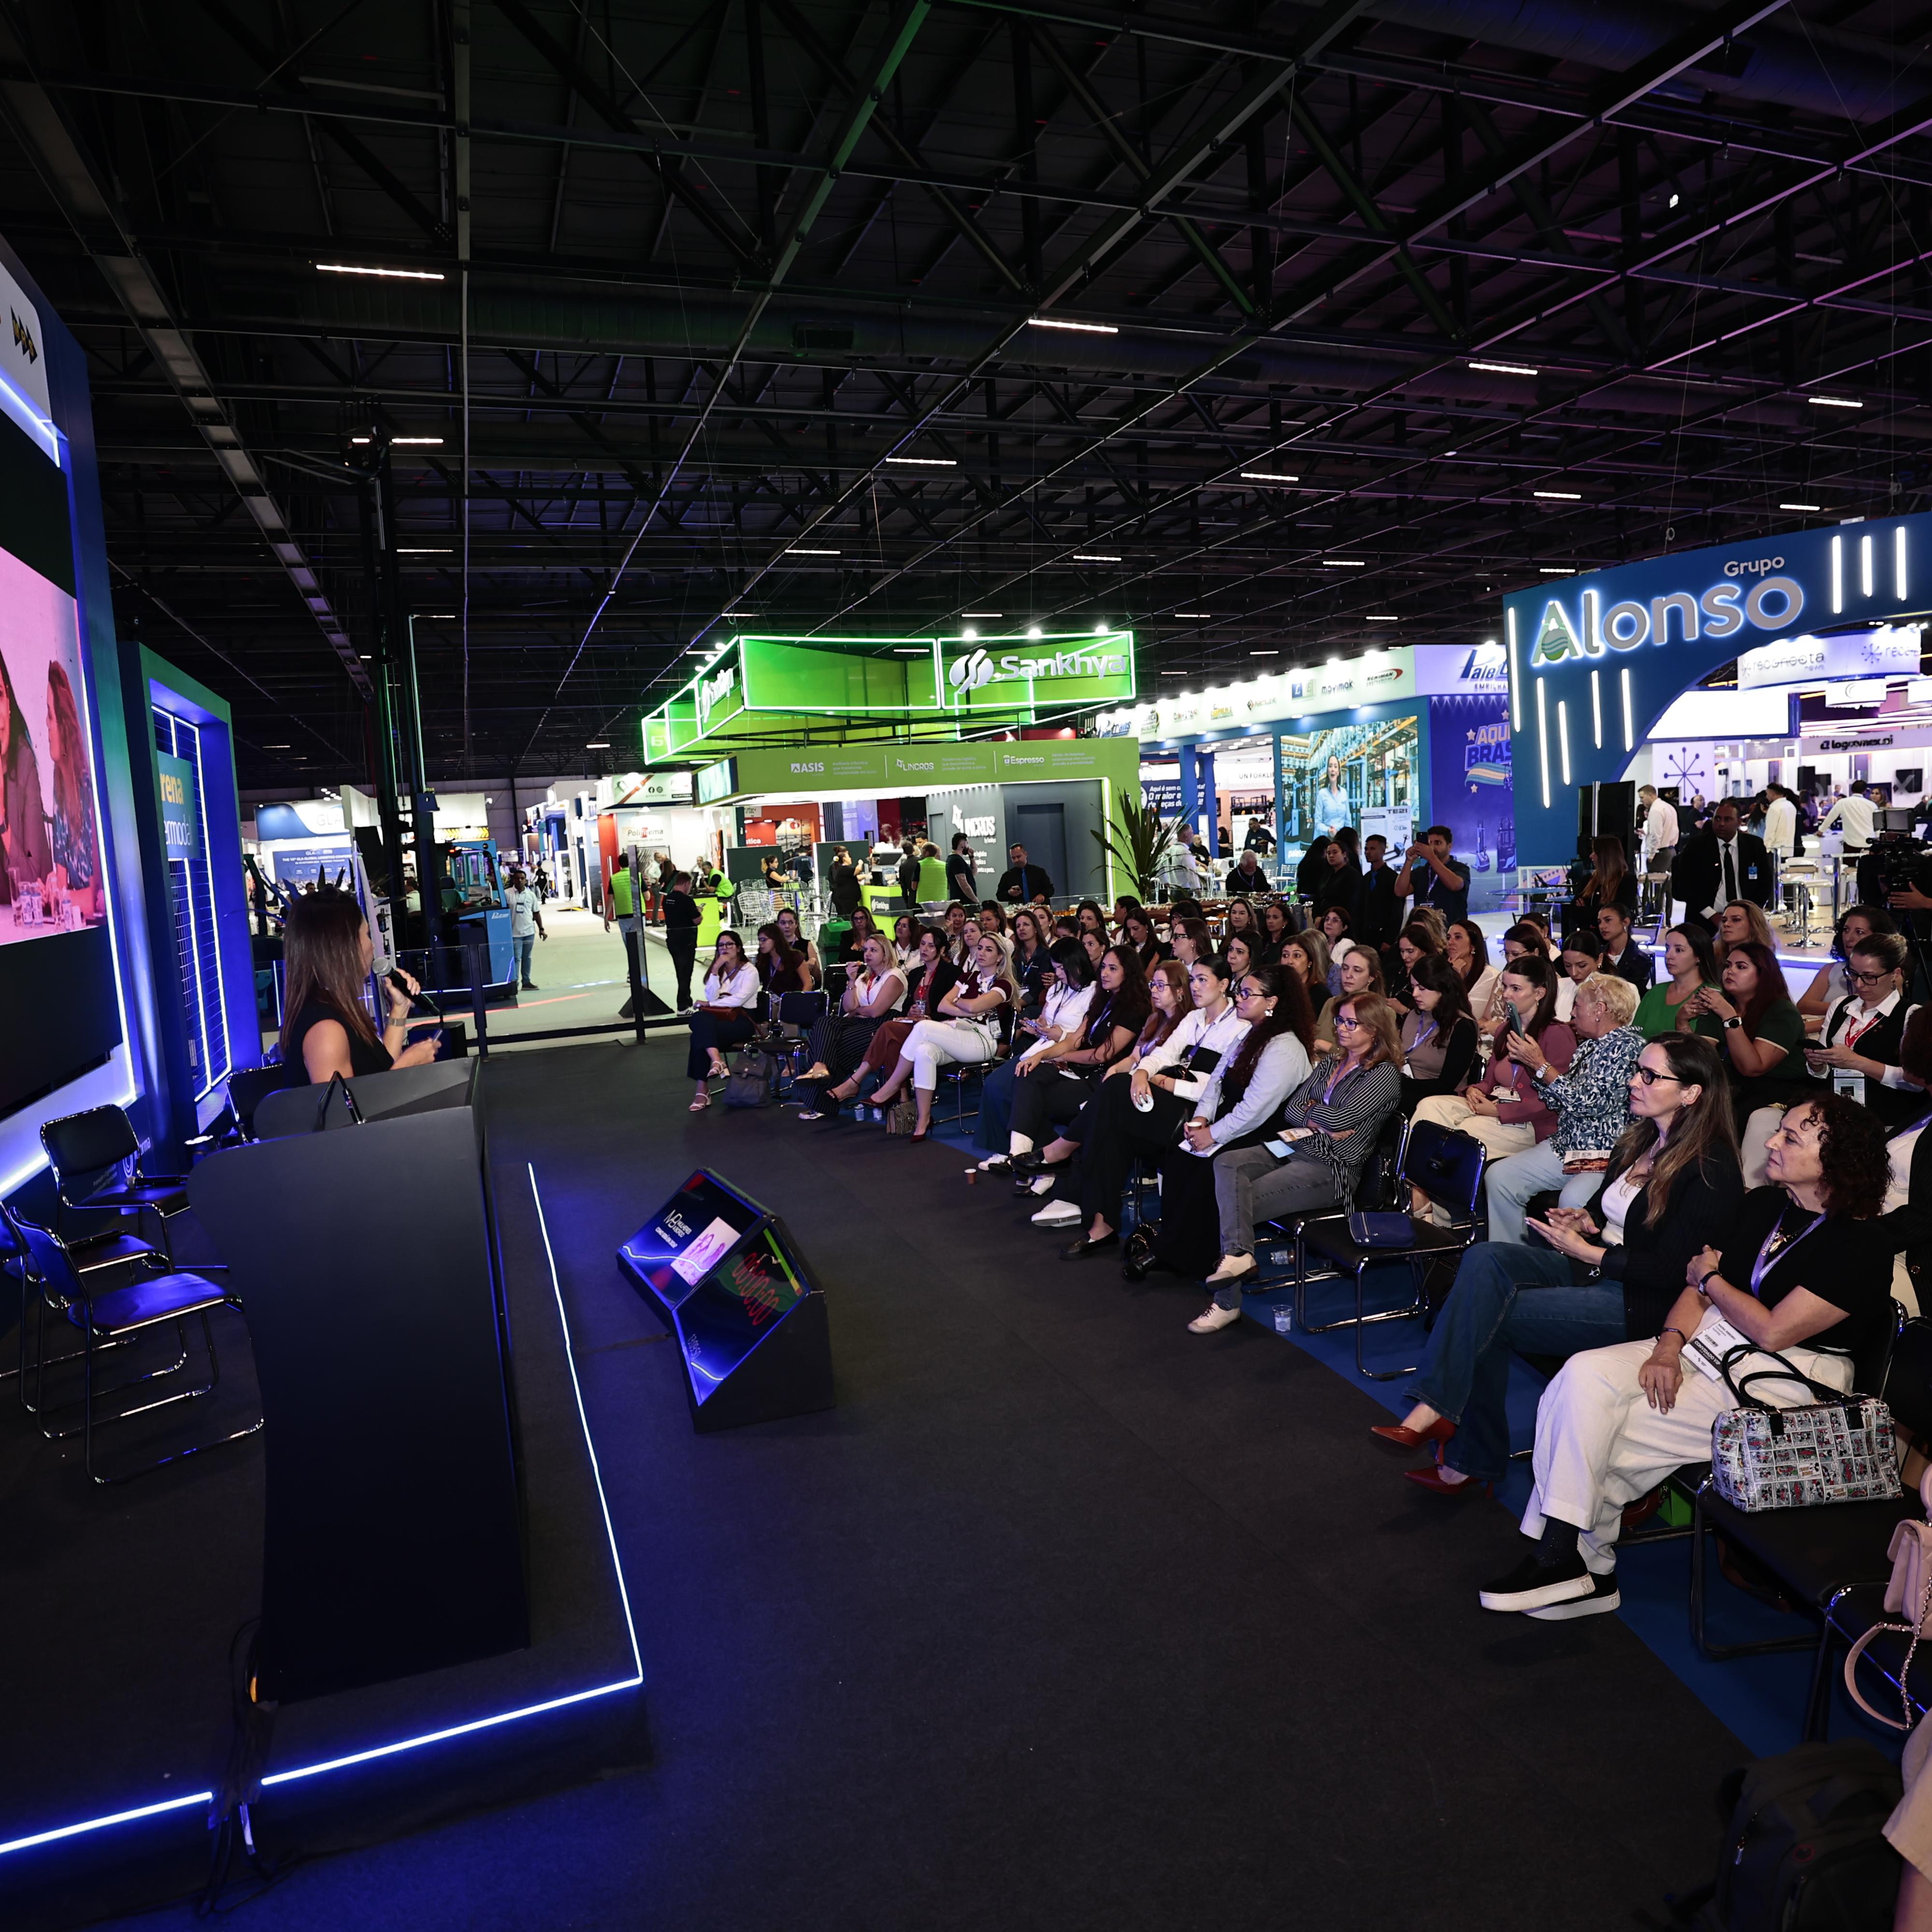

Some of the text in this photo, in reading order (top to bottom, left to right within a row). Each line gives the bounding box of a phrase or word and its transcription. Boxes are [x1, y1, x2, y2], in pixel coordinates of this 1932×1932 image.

[1724, 556, 1786, 577] Grupo
[1531, 576, 1804, 666] Alonso
[1001, 652, 1126, 679] Sankhya
[903, 762, 934, 771] LINCROS
[1010, 756, 1045, 765] Espresso
[801, 762, 824, 772] ASIS
[160, 773, 184, 804] rena
[1148, 792, 1154, 800] O
[1161, 801, 1175, 810] eças
[317, 814, 342, 826] GLA
[1694, 1340, 1715, 1360] CONVIDADO
